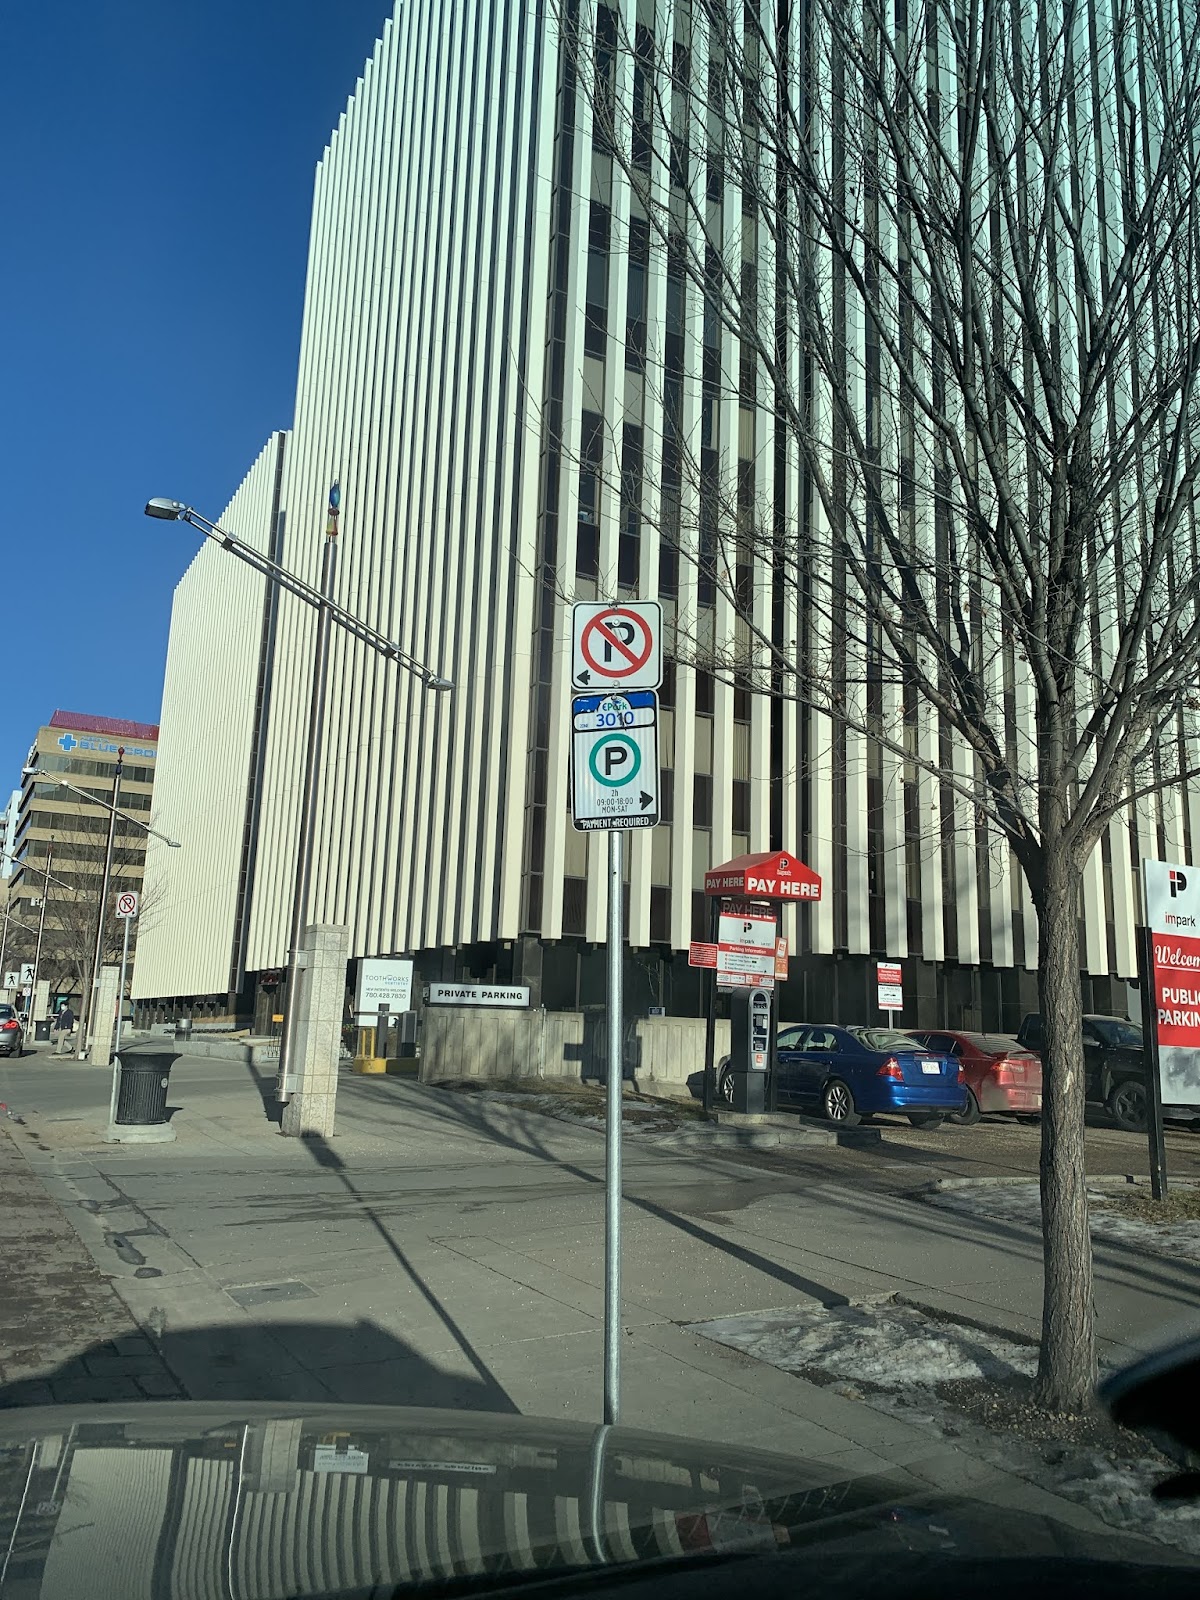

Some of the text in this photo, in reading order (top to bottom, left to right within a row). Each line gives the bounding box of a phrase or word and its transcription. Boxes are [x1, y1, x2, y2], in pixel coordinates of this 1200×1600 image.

[604, 622, 635, 663] P
[596, 711, 634, 727] 3010
[80, 741, 117, 753] BLUE
[605, 746, 628, 776] P
[611, 789, 619, 797] 2h
[597, 797, 634, 806] 09:00-18:00
[602, 805, 628, 813] MON-SAT
[582, 816, 649, 829] PAYMENT REQUIRED
[706, 876, 744, 889] PAY HERE
[747, 877, 820, 897] PAY HERE
[722, 902, 774, 919] PAY HERE
[1165, 912, 1196, 928] impark
[365, 974, 409, 983] TOOTHWORKS
[437, 989, 523, 1000] PRIVATE PARKING
